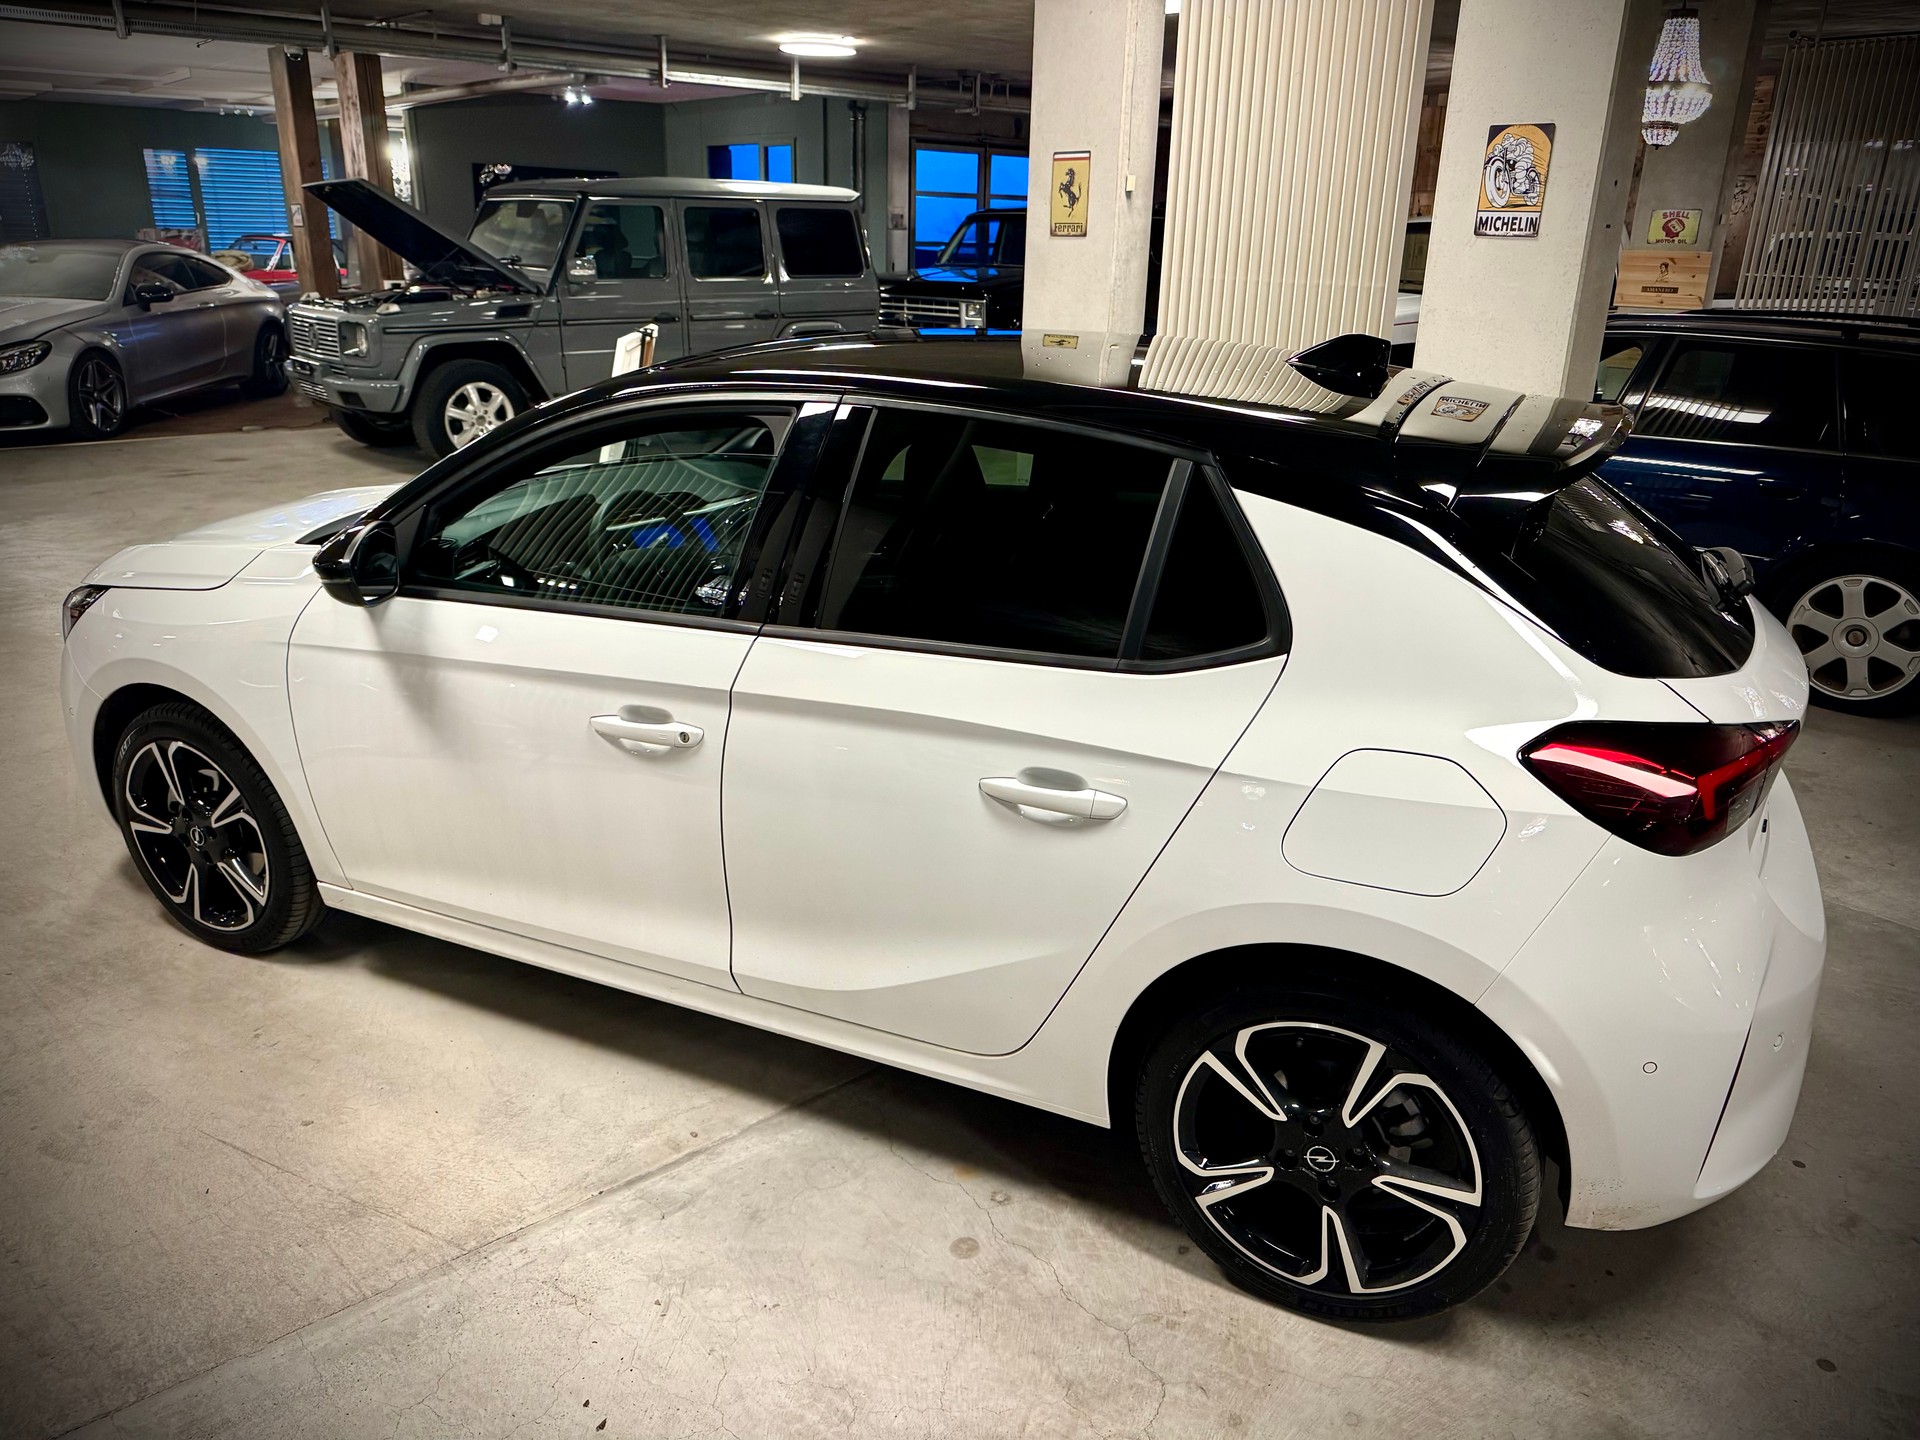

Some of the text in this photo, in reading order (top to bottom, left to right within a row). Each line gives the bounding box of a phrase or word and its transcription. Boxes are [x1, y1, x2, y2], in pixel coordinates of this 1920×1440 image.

[1662, 211, 1690, 219] SHELL
[1054, 222, 1083, 232] Ferrari
[1478, 216, 1538, 232] MICHELIN
